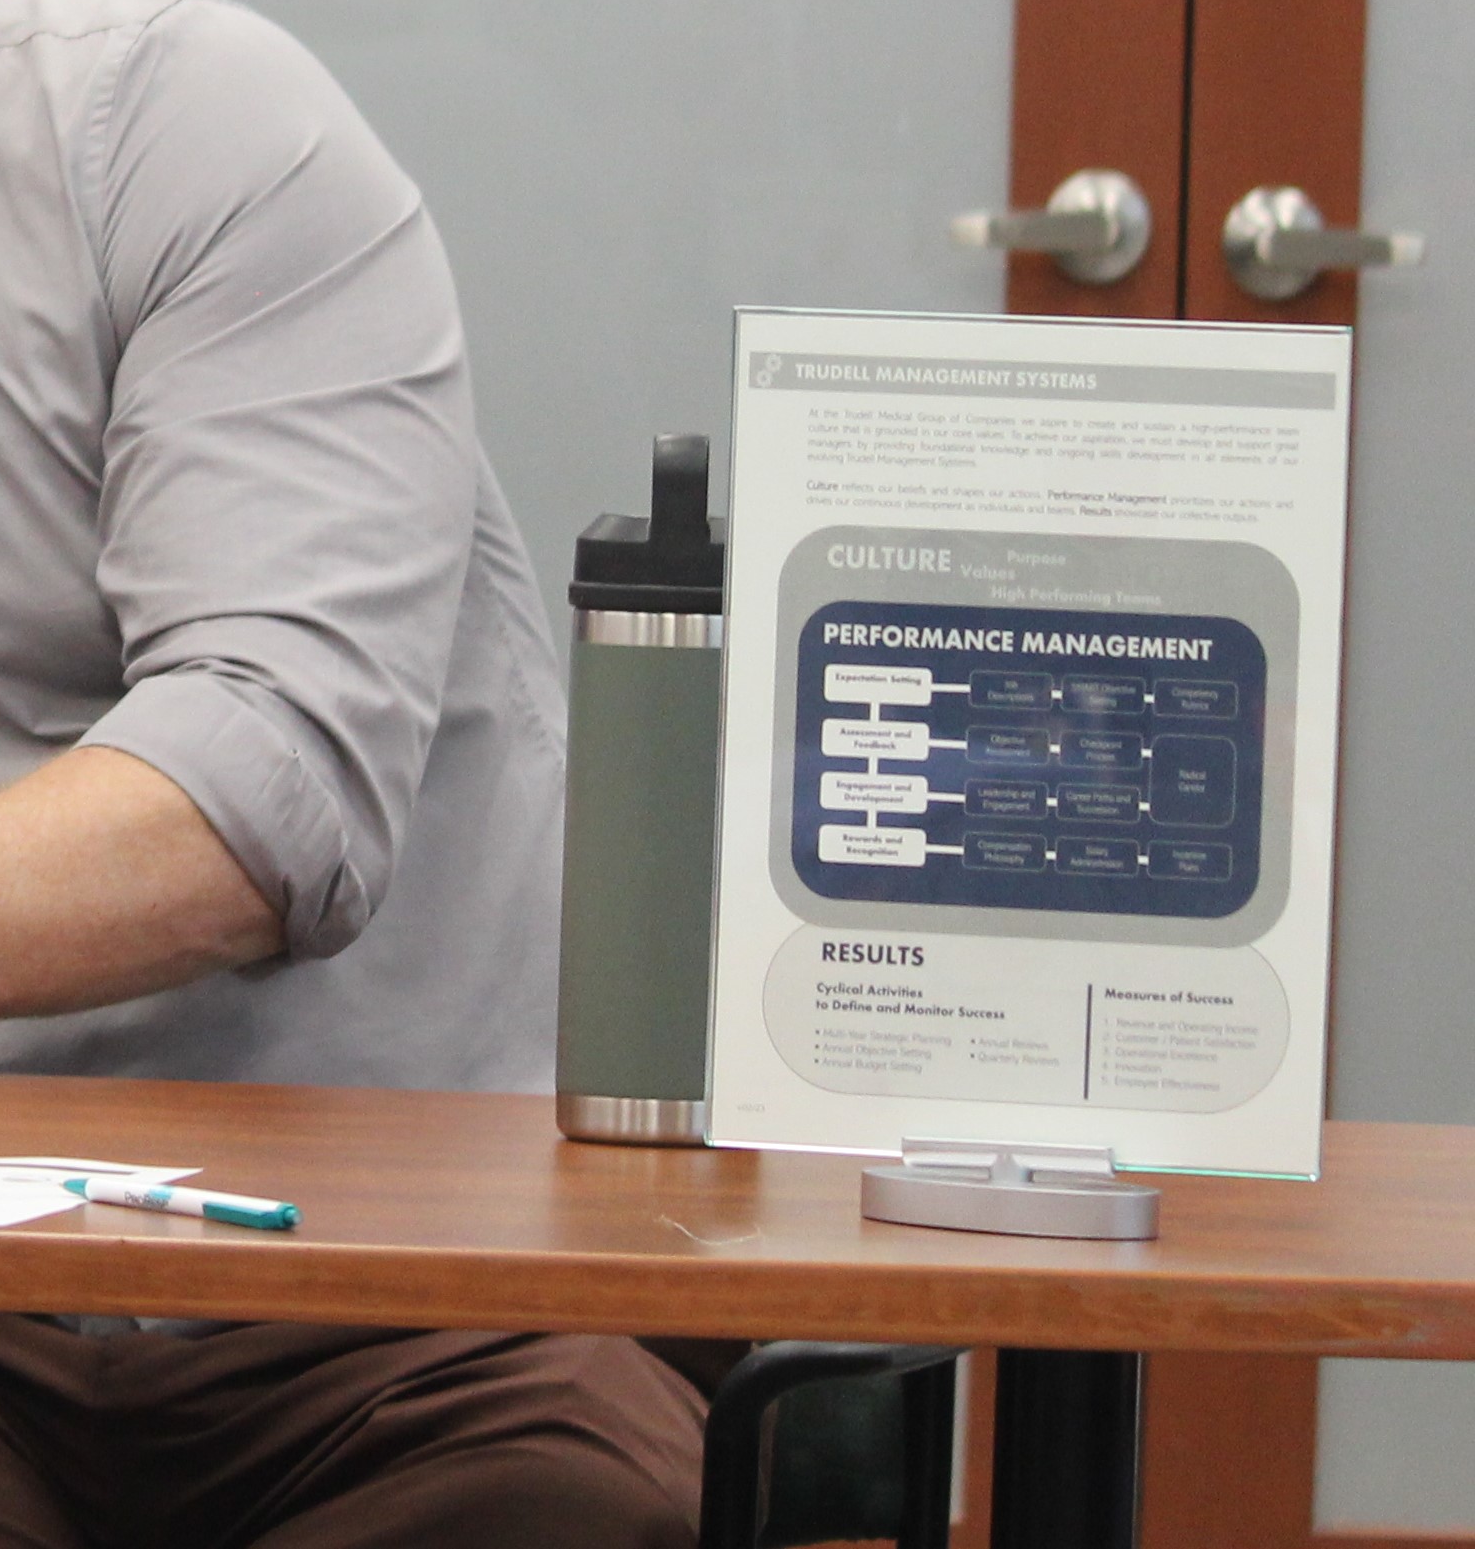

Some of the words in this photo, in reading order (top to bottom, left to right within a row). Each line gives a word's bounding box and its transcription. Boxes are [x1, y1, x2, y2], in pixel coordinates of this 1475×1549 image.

[795, 362, 870, 381] TRUDELL
[875, 365, 1010, 386] MANAGEMENT
[1016, 371, 1098, 390] SYSTEMS
[806, 480, 838, 490] Culture
[827, 544, 951, 572] CULTURE
[1006, 550, 1066, 567] Purpose
[960, 564, 1016, 581] Values
[991, 586, 1026, 603] High
[1029, 588, 1112, 607] Performing
[823, 623, 1014, 653] PERFORMANCE
[1021, 629, 1213, 661] MANAGEMENT
[822, 942, 925, 966] RESULTS
[816, 982, 863, 996] Cyclical
[867, 984, 923, 998] Activities
[1104, 988, 1166, 1002] Measures
[1170, 991, 1182, 1002] of
[1187, 992, 1234, 1004] Success
[816, 999, 828, 1011] to
[832, 1000, 872, 1012] Define
[876, 1002, 900, 1014] and
[904, 1003, 954, 1017] Monitor
[958, 1006, 1005, 1020] Success
